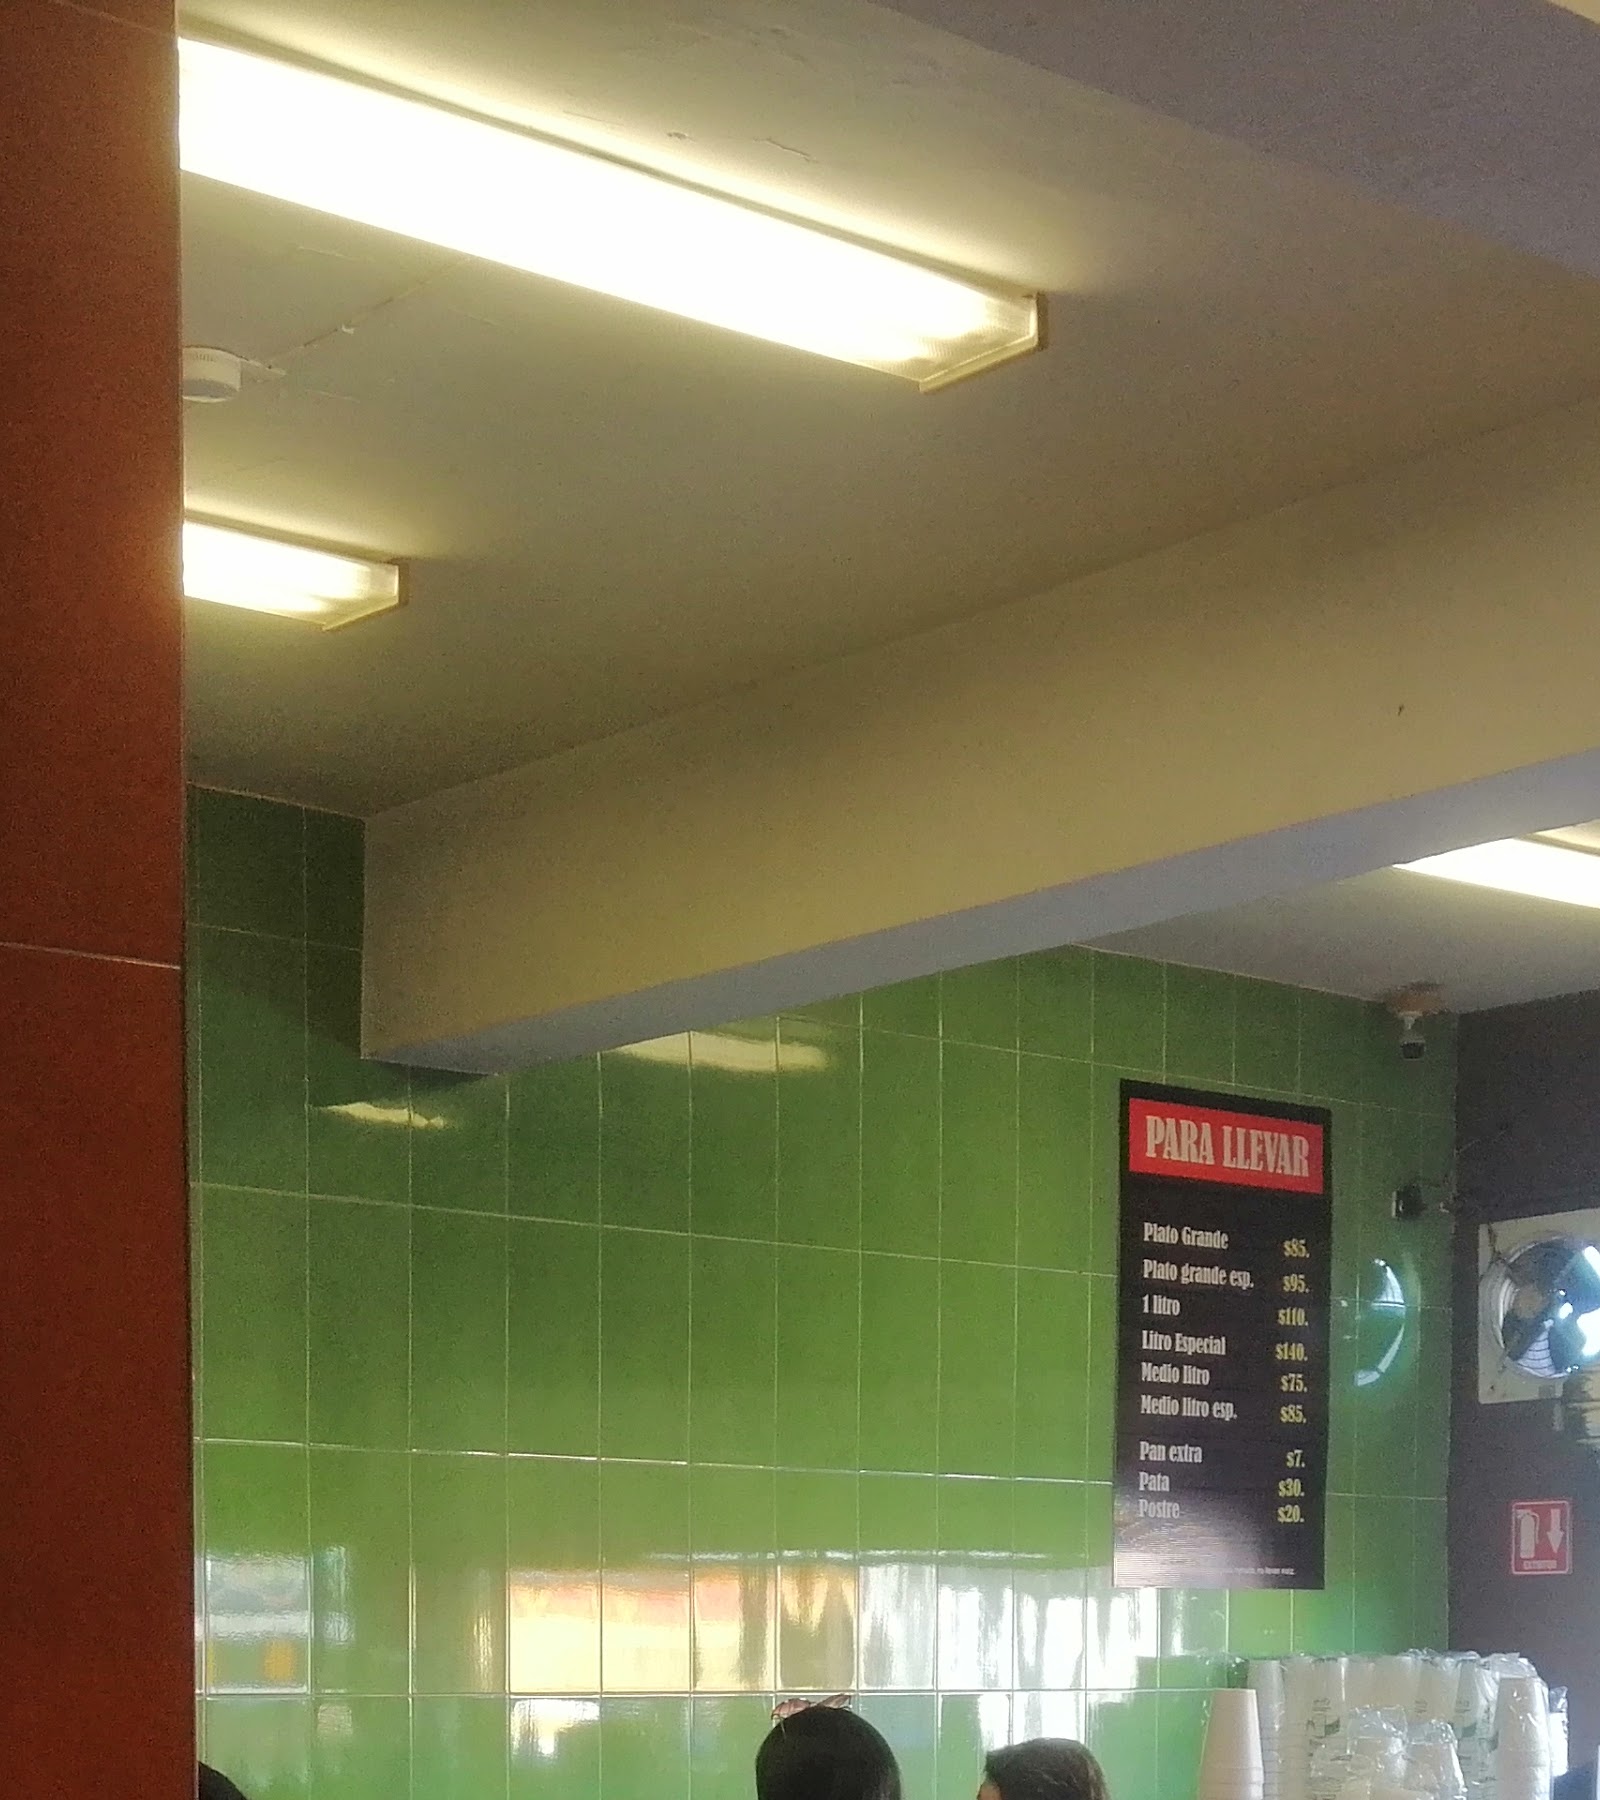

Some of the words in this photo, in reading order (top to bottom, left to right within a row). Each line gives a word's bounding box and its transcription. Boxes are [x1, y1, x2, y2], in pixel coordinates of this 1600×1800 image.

[1145, 1115, 1215, 1165] PARA
[1222, 1125, 1310, 1177] LLEVAR
[1143, 1222, 1178, 1244] Plato
[1182, 1227, 1229, 1250] Grande
[1283, 1238, 1310, 1258] $85.
[1142, 1259, 1177, 1281] Plato
[1180, 1262, 1227, 1286] grande
[1230, 1270, 1255, 1290] esp.
[1283, 1274, 1310, 1293] $95.
[1142, 1294, 1150, 1314] 1
[1153, 1294, 1180, 1316] litro
[1142, 1329, 1172, 1351] Litro
[1175, 1333, 1226, 1355] Especial
[1141, 1362, 1179, 1383] Medio
[1182, 1364, 1210, 1386] litro
[1280, 1373, 1308, 1393] $75.
[1140, 1394, 1179, 1416] Medio
[1181, 1397, 1209, 1417] litro
[1212, 1401, 1237, 1421] esp.
[1139, 1441, 1166, 1462] Pan
[1169, 1444, 1203, 1464] extra
[1138, 1471, 1170, 1492] Pata
[1138, 1499, 1180, 1519] Postre
